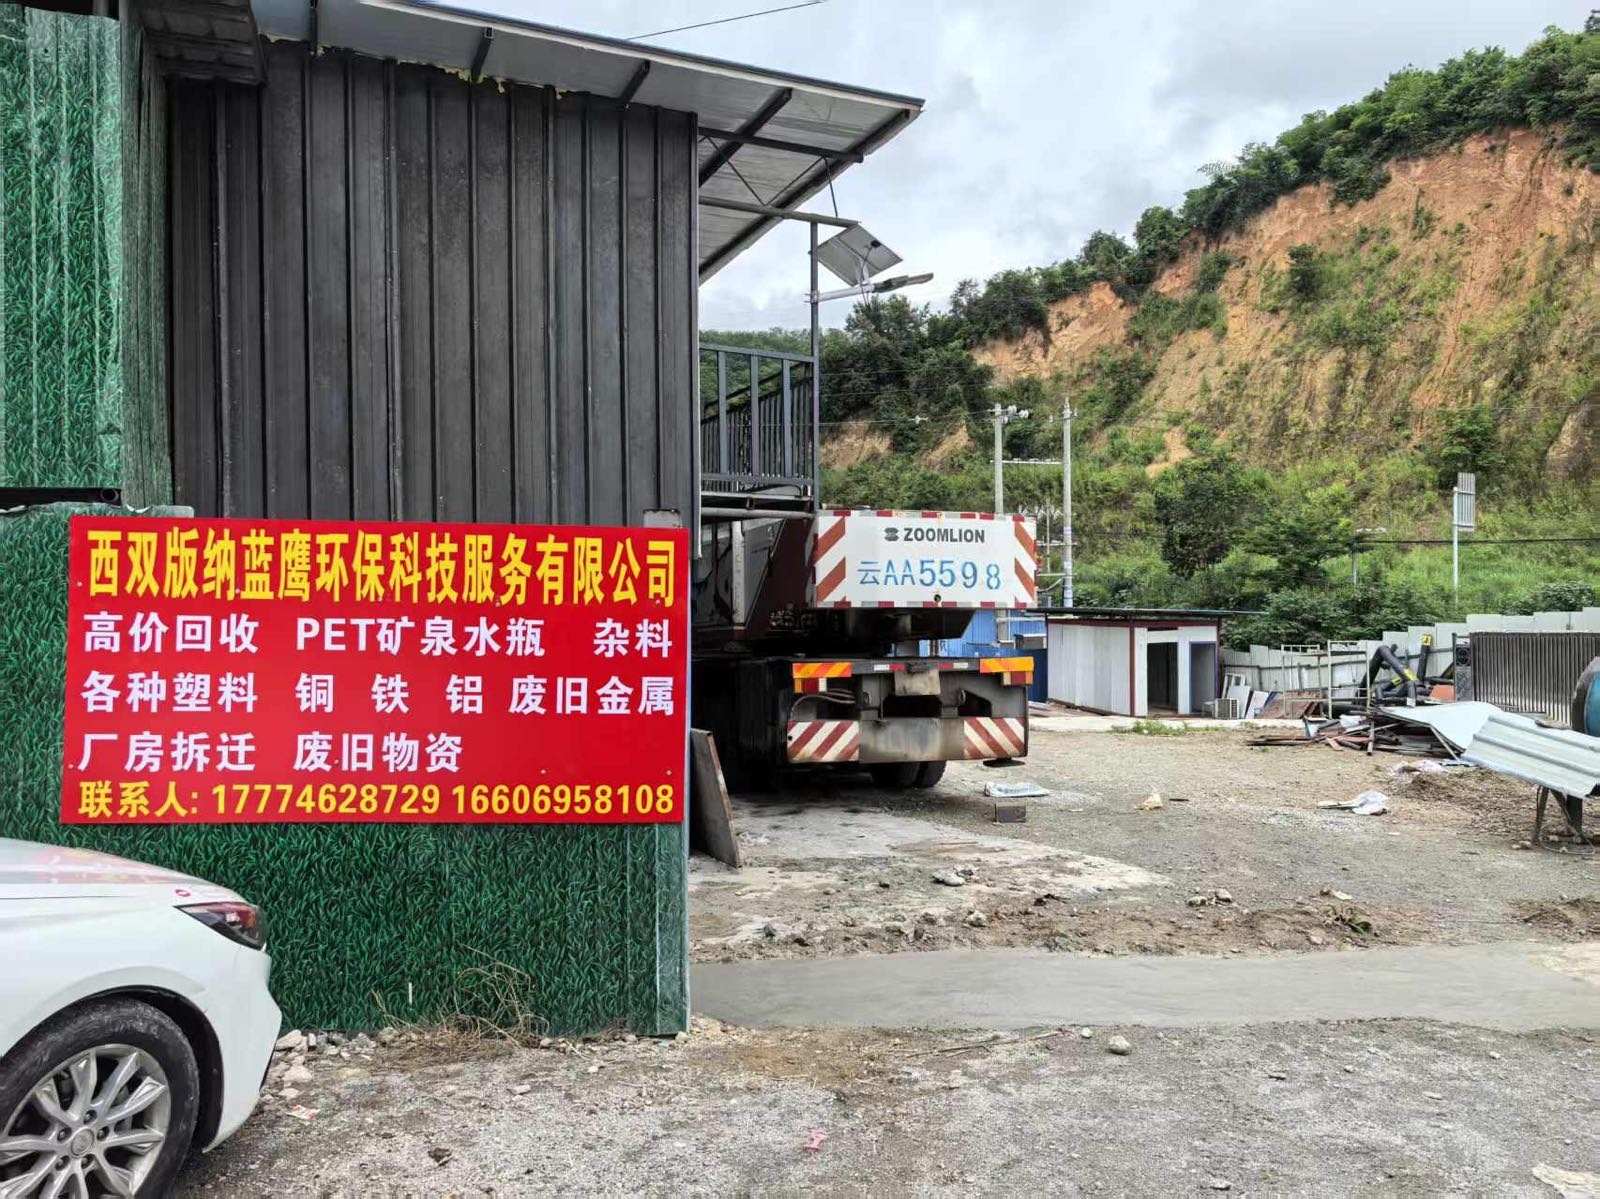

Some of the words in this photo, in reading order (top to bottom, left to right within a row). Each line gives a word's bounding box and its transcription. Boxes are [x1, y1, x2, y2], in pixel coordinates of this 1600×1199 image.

[903, 527, 985, 543] ZOOMLION
[87, 526, 676, 608] 西双版纳蓝鹰环保科技服务有限公司
[857, 559, 1001, 590] 云AA5598
[83, 610, 260, 654] 高价回收
[296, 615, 546, 657] PET矿泉水瓶
[593, 617, 673, 658] 杂料
[80, 669, 258, 713] 各种塑料
[294, 672, 334, 713] 铜
[371, 673, 410, 714] 铁
[446, 674, 483, 715] 铝
[508, 674, 674, 716] 废旧金属
[77, 731, 256, 773] 厂房拆迁
[292, 730, 463, 773] 废旧物资
[212, 783, 440, 814] 17774628729
[452, 784, 674, 815] 16606958108
